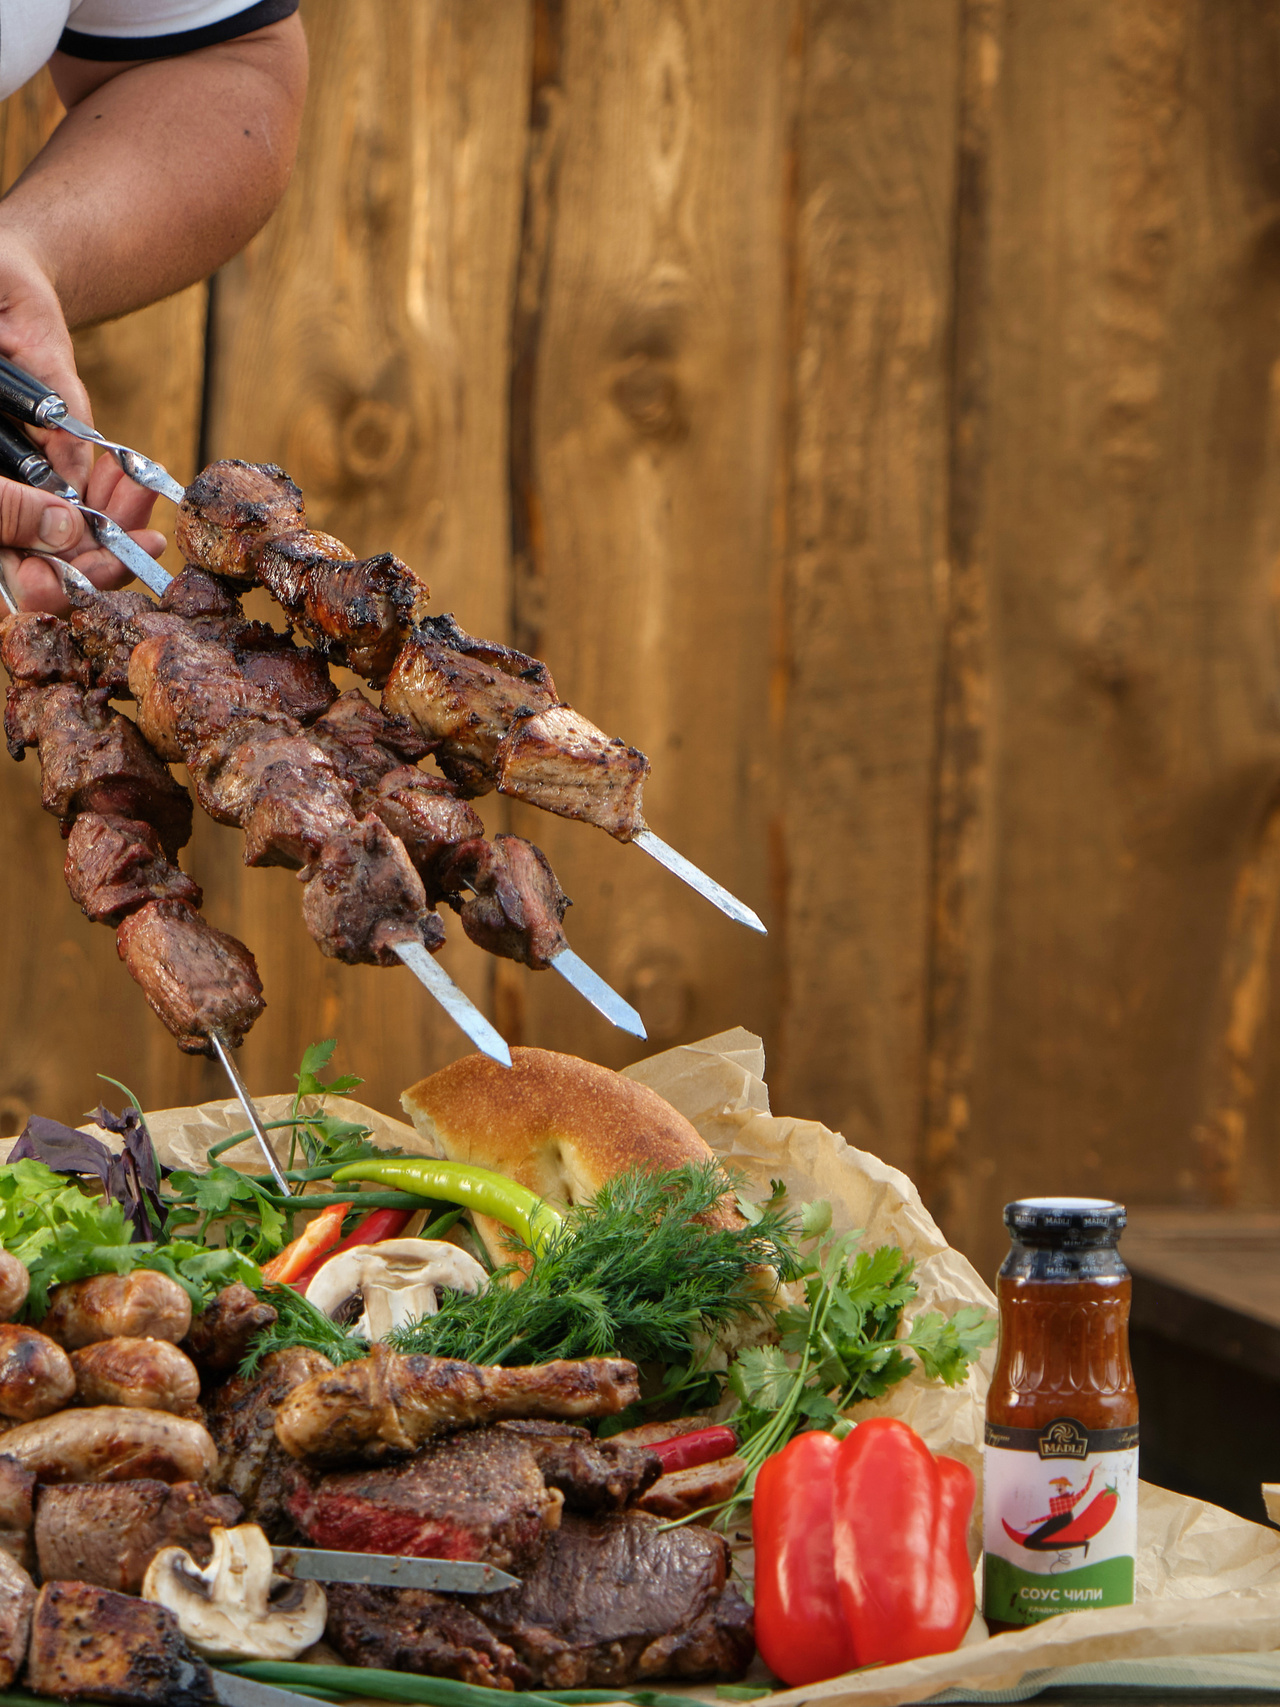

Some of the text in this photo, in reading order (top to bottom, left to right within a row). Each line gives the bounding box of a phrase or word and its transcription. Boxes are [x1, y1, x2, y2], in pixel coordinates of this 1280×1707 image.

[1044, 1443, 1083, 1454] MADLI
[1020, 1587, 1103, 1601] СОУС ЧИЛИ
